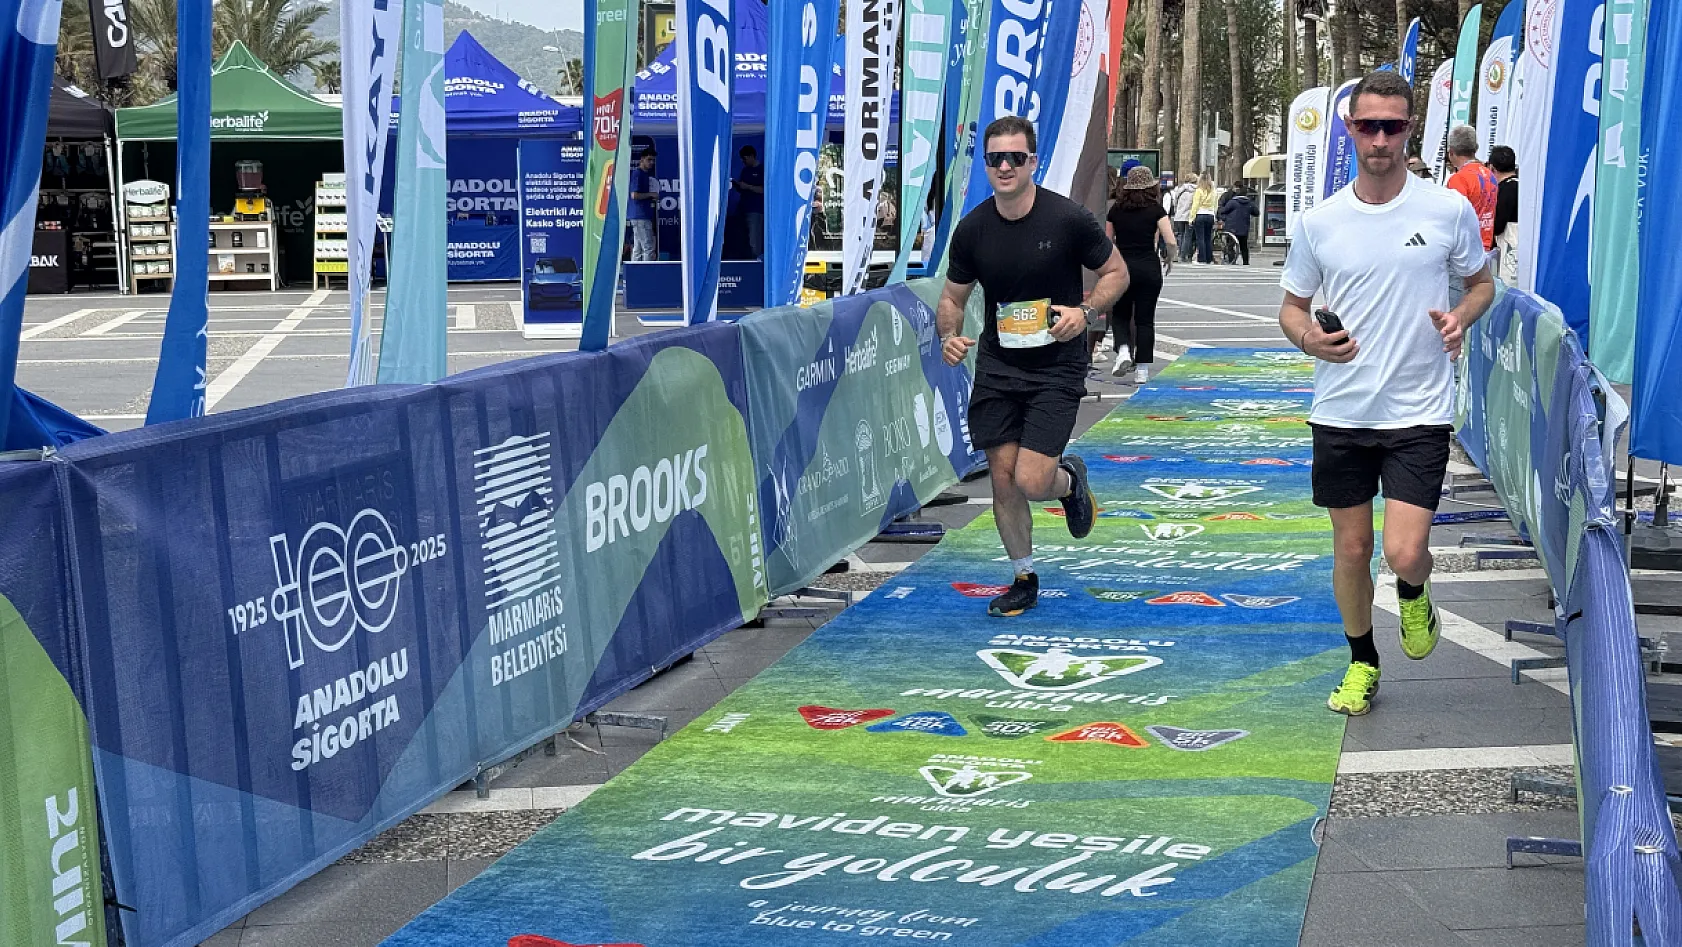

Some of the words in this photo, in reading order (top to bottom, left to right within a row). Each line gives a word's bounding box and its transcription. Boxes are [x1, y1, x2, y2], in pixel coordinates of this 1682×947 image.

[446, 179, 518, 193] ADOL
[556, 219, 583, 229] Sigort
[1013, 308, 1038, 321] 562
[797, 356, 837, 391] GARMIN
[585, 443, 708, 553] BROOKS
[411, 533, 446, 567] 2025
[228, 596, 268, 635] 1925
[488, 586, 563, 646] MARMARİS
[491, 623, 567, 688] BELEDİYESİ
[294, 648, 409, 730] ANADOLU
[291, 694, 400, 771] SİGORTA
[660, 807, 970, 842] maviden
[985, 827, 1212, 860] yesile
[630, 826, 784, 865] bir
[739, 845, 1179, 897] yolculuk
[750, 913, 817, 928] blue
[822, 918, 855, 932] to
[858, 924, 953, 941] green
[757, 901, 896, 925] journey
[898, 909, 980, 927] from
